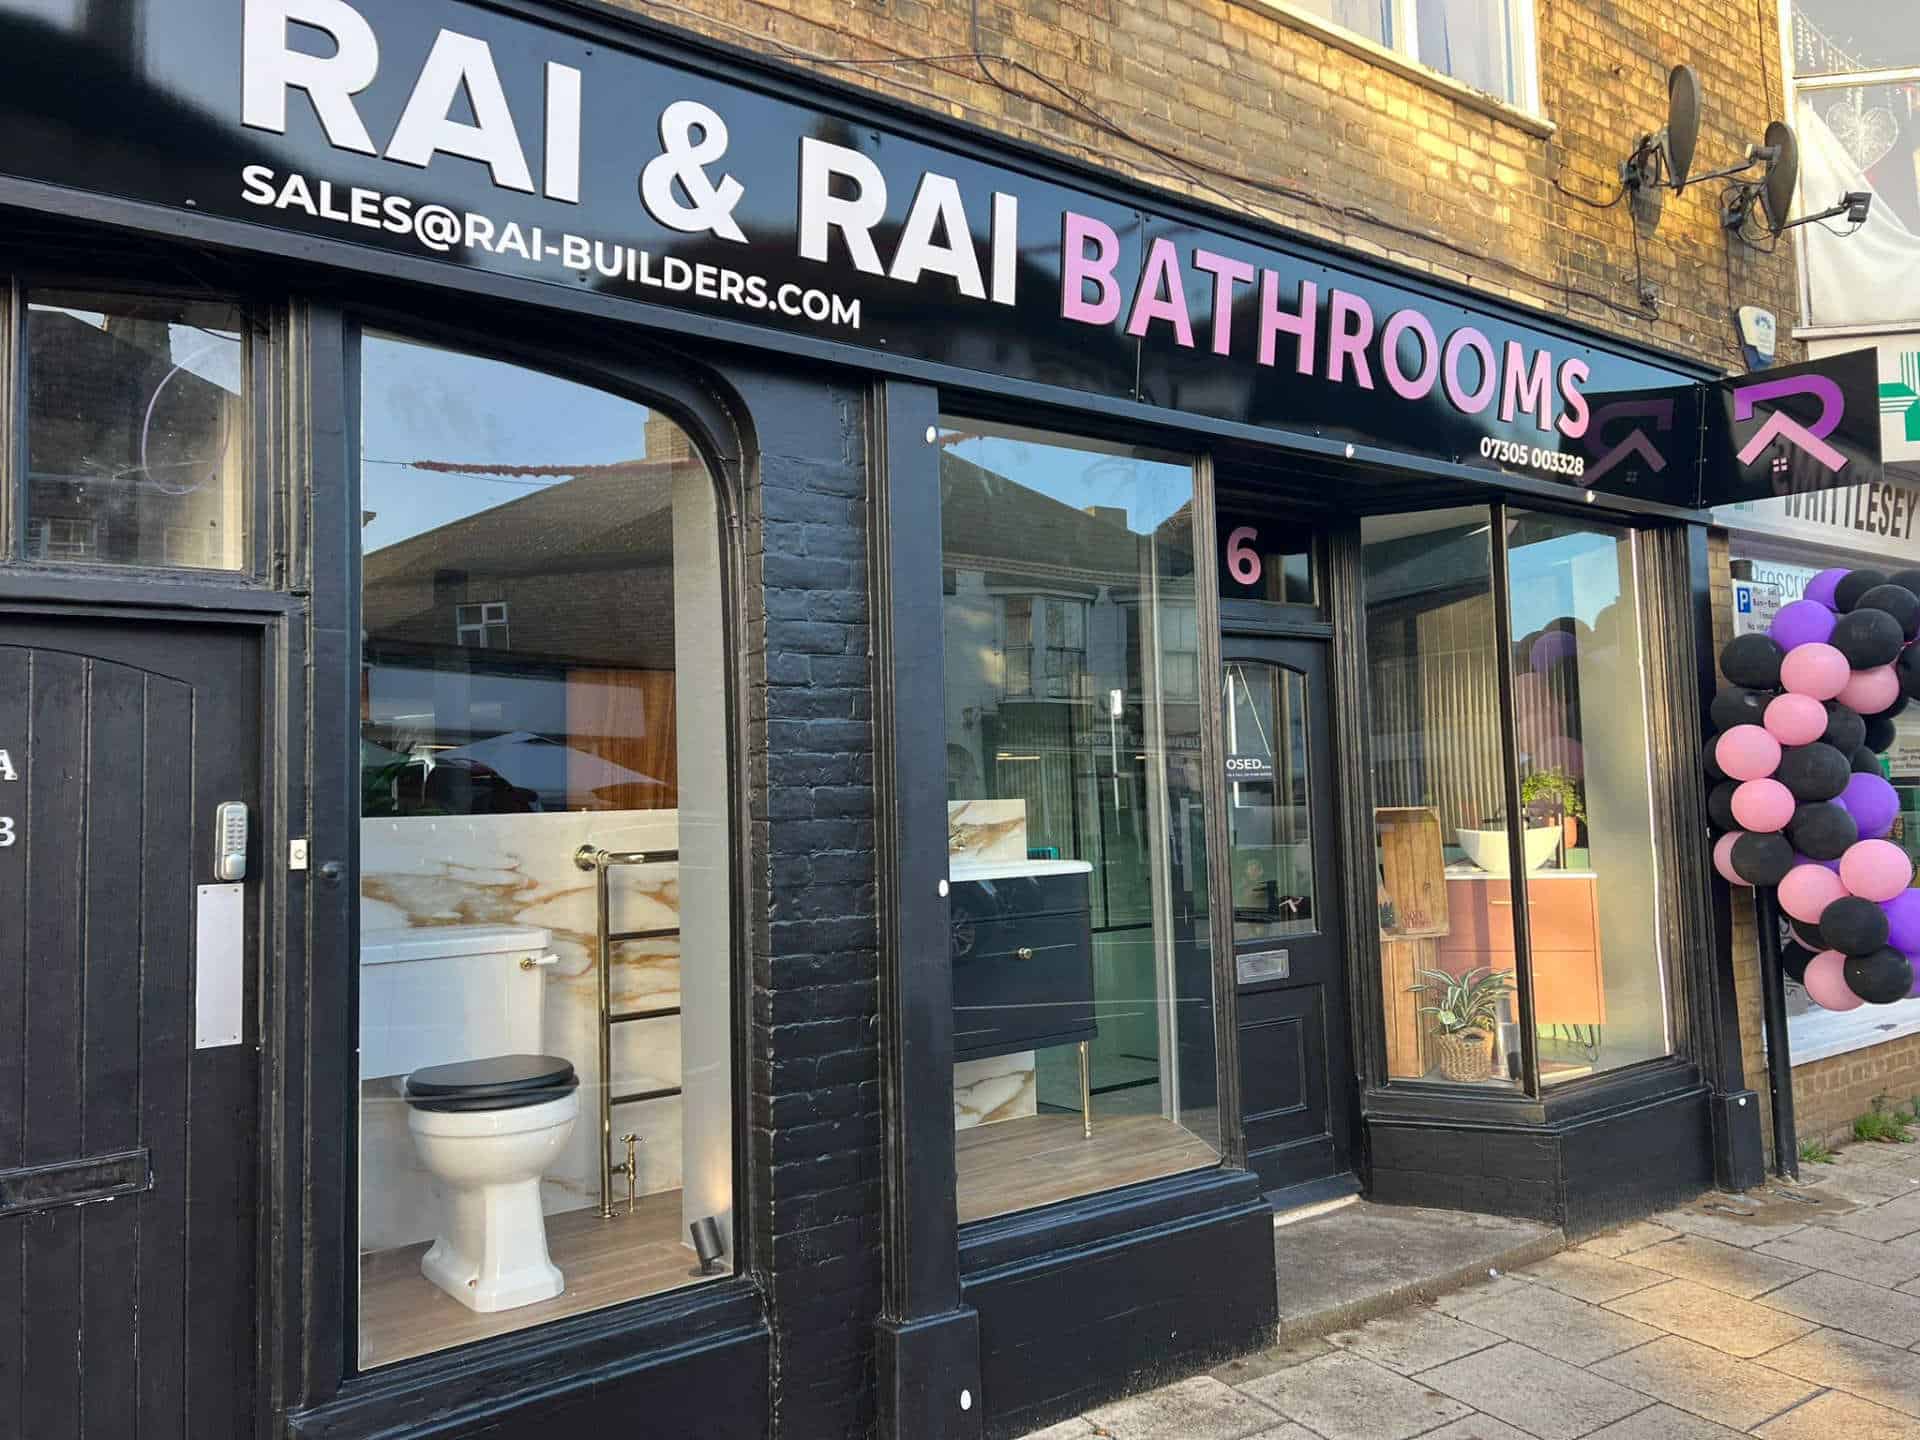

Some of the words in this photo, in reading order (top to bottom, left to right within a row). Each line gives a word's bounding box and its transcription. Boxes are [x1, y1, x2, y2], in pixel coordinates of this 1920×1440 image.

[241, 165, 861, 330] SALES@RAI-BUILDERS.COM
[243, 0, 582, 204] RAI
[641, 100, 750, 244] &
[800, 136, 1018, 307] RAI
[1062, 211, 1591, 440] BATHROOMS
[1480, 436, 1529, 466] 07305
[1531, 447, 1585, 478] 003328
[1226, 526, 1262, 586] 6
[1739, 589, 1750, 612] P
